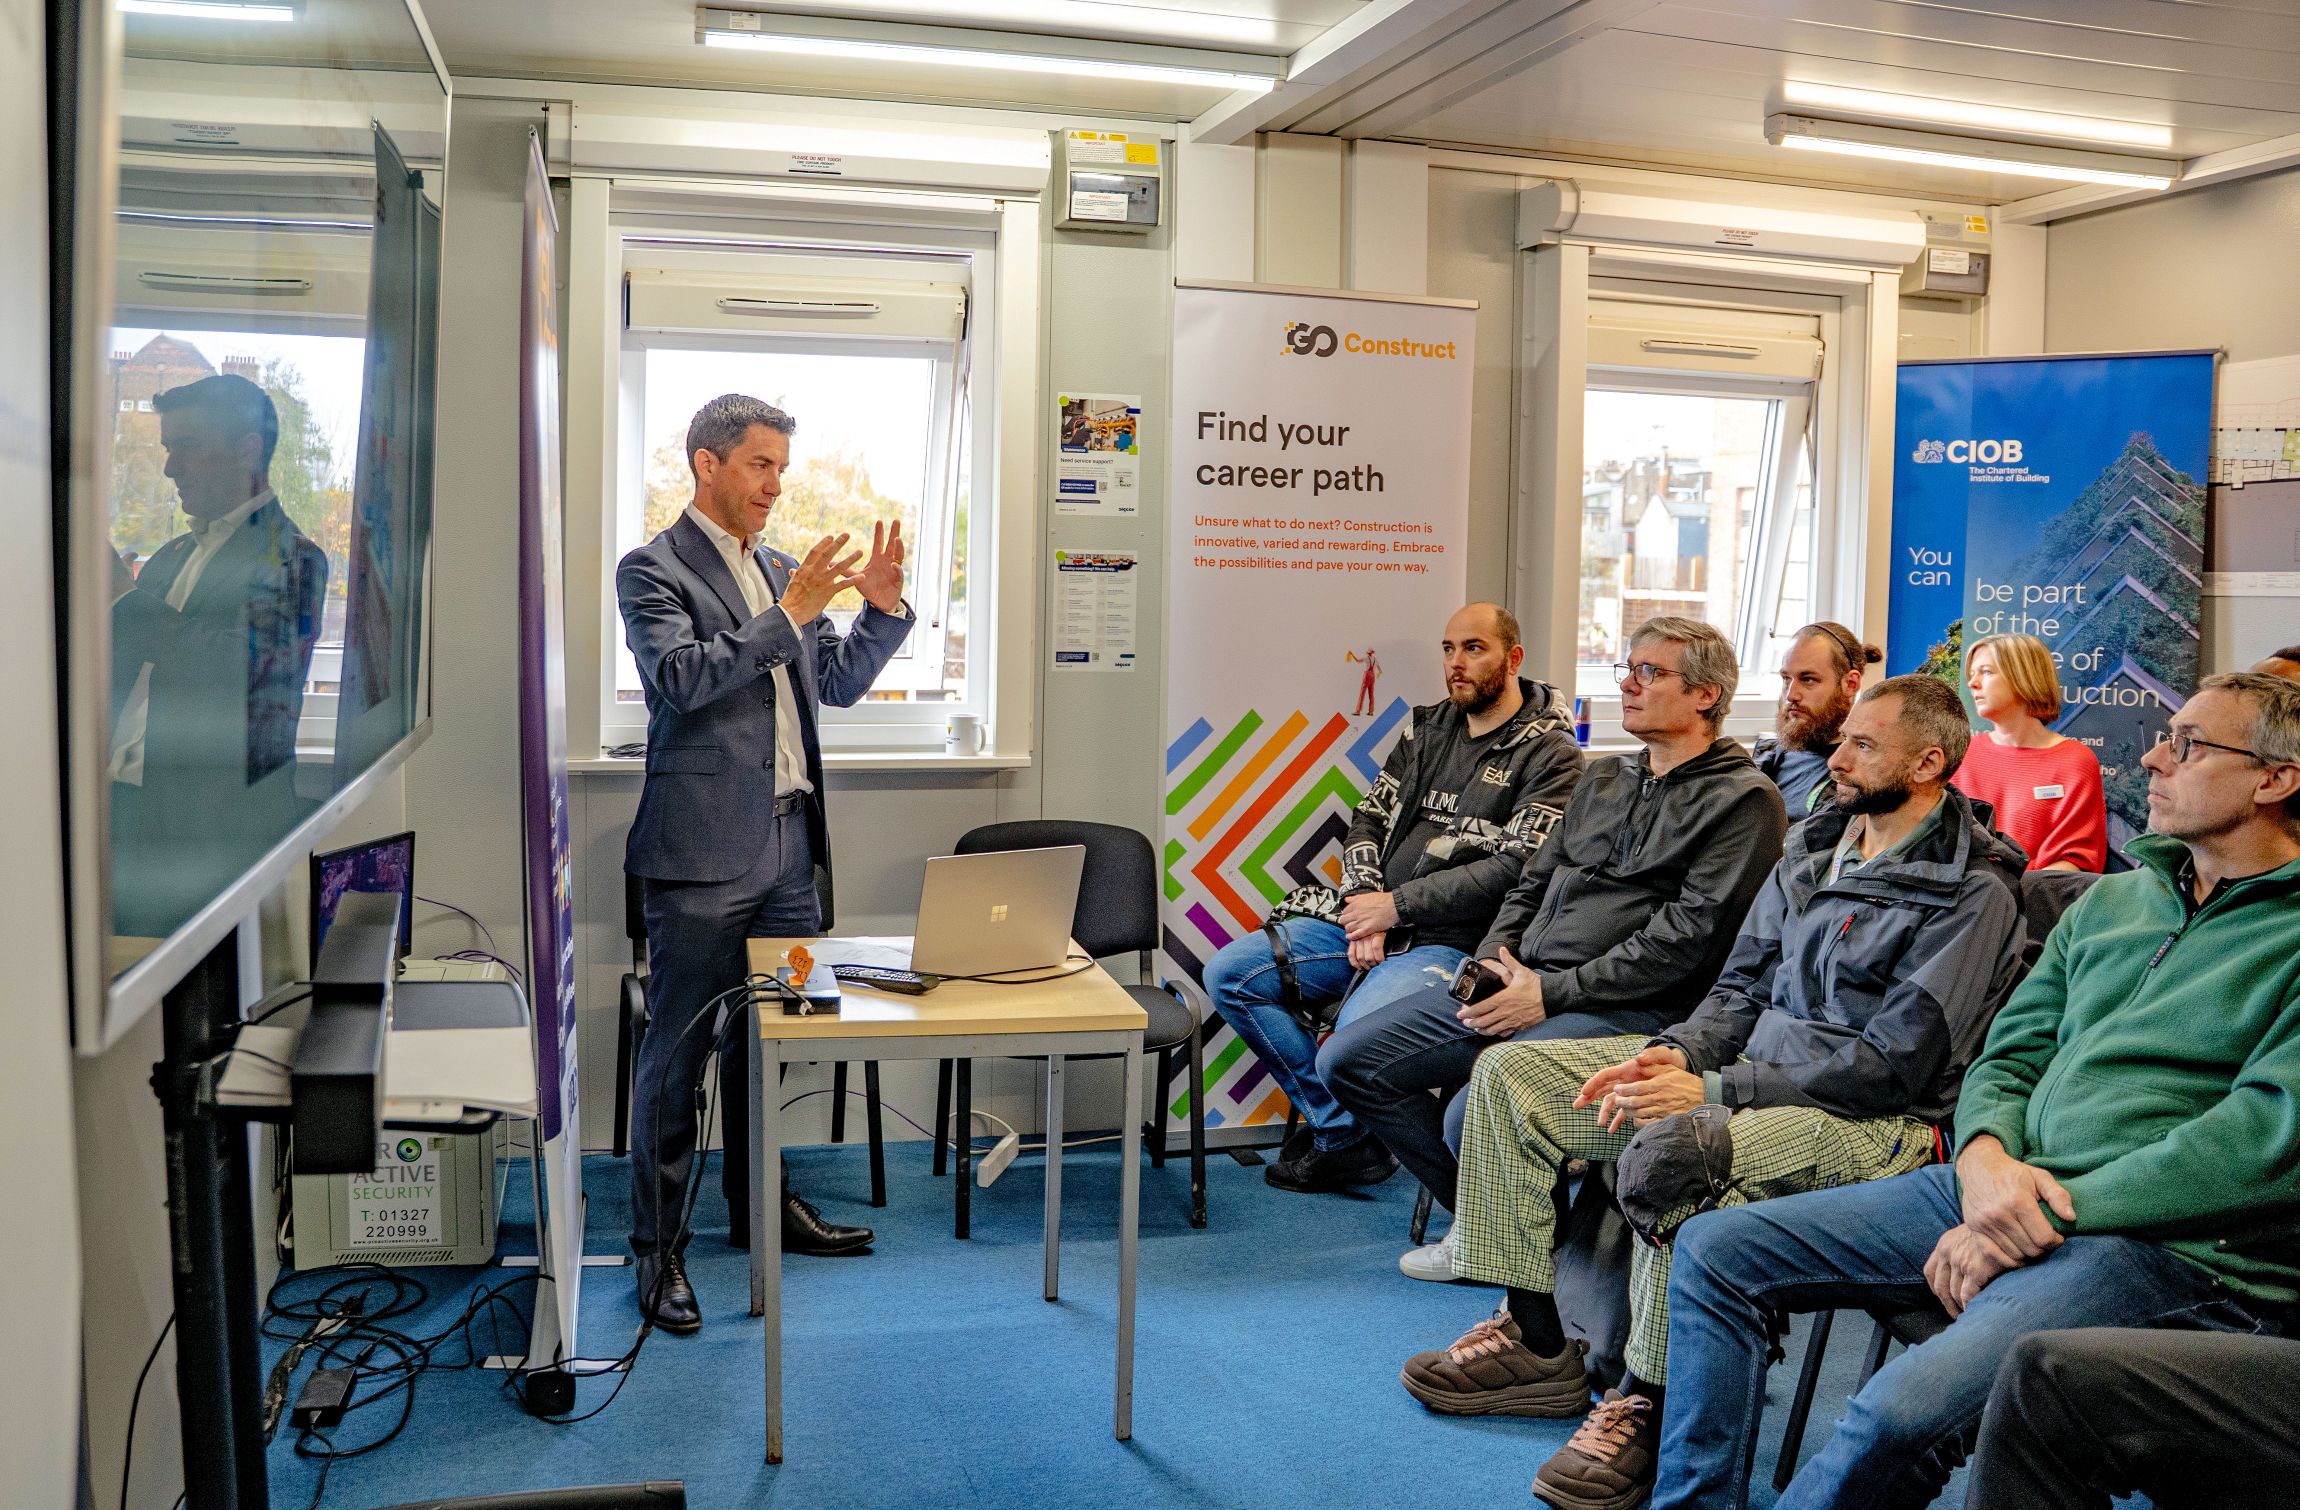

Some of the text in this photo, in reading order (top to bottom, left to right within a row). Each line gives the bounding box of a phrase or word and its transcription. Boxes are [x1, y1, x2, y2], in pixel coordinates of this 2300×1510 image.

[1344, 332, 1457, 360] Construct
[1197, 411, 1351, 451] Find your
[1946, 439, 2024, 464] CIOB
[1196, 464, 1385, 497] career path
[1969, 467, 2029, 475] The Chartered
[1970, 474, 2050, 484] Institute of Building
[1194, 515, 1433, 534] Unsure what to do next? Construction is
[1194, 535, 1445, 554] innovative, varied and rewarding. Embrace
[1194, 556, 1429, 575] the possibilities and pave your own way.
[1908, 546, 1952, 566] You
[1908, 571, 1951, 586] can
[1976, 578, 2087, 608] be part
[1973, 611, 2060, 637] of the
[2071, 647, 2105, 671] of
[2081, 736, 2104, 747] and
[2100, 765, 2117, 776] ho
[1428, 814, 1454, 825] PARIS
[353, 1165, 436, 1184] ACTIVE
[353, 1186, 434, 1200] SECURITY
[361, 1209, 430, 1222] T: 01327
[366, 1224, 428, 1238] 220999
